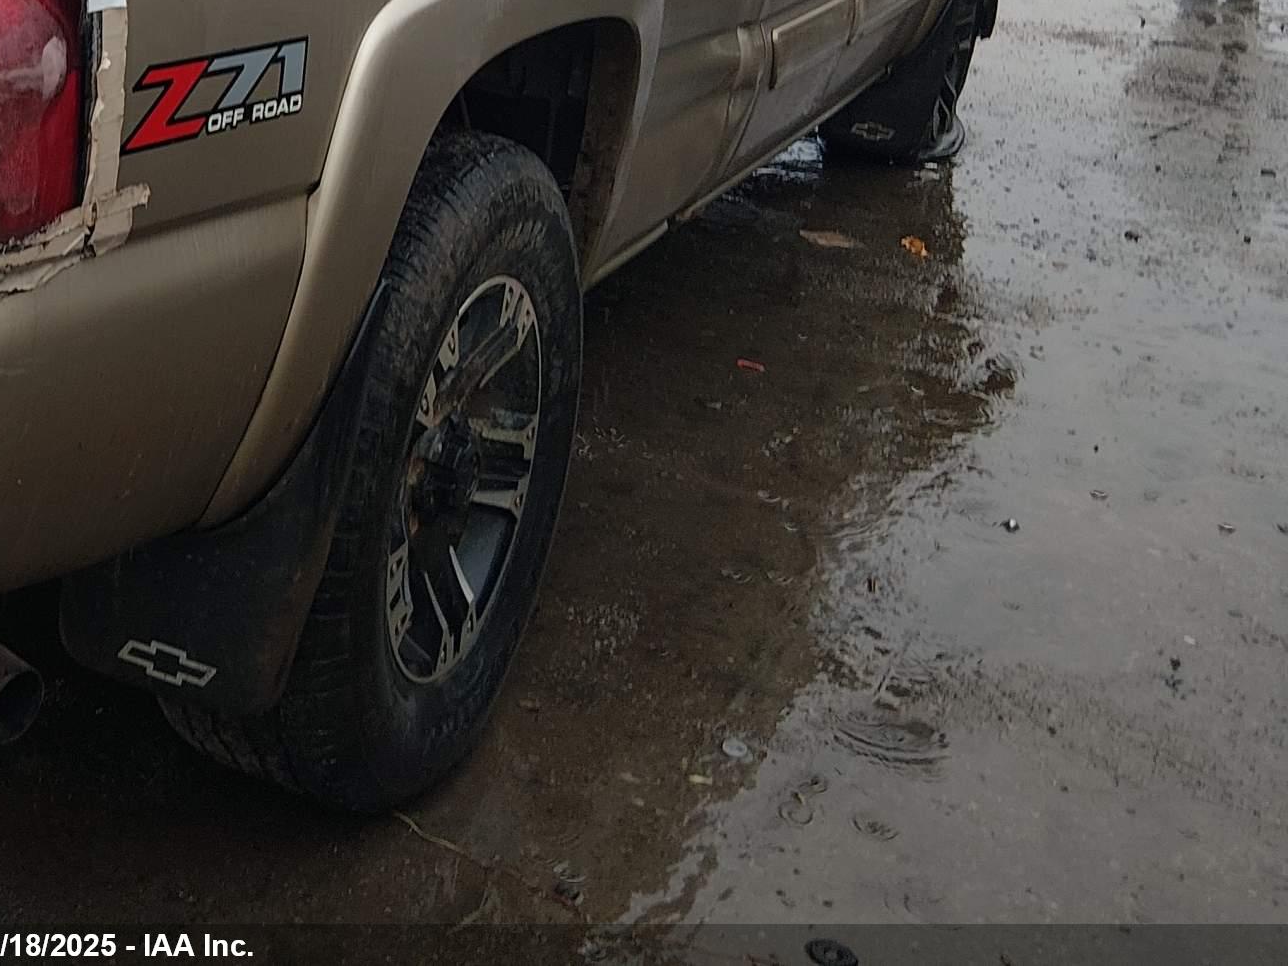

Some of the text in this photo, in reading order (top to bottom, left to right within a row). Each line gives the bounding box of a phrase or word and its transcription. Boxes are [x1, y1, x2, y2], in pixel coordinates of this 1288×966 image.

[121, 36, 308, 154] Z71
[207, 93, 303, 134] OFF ROAD
